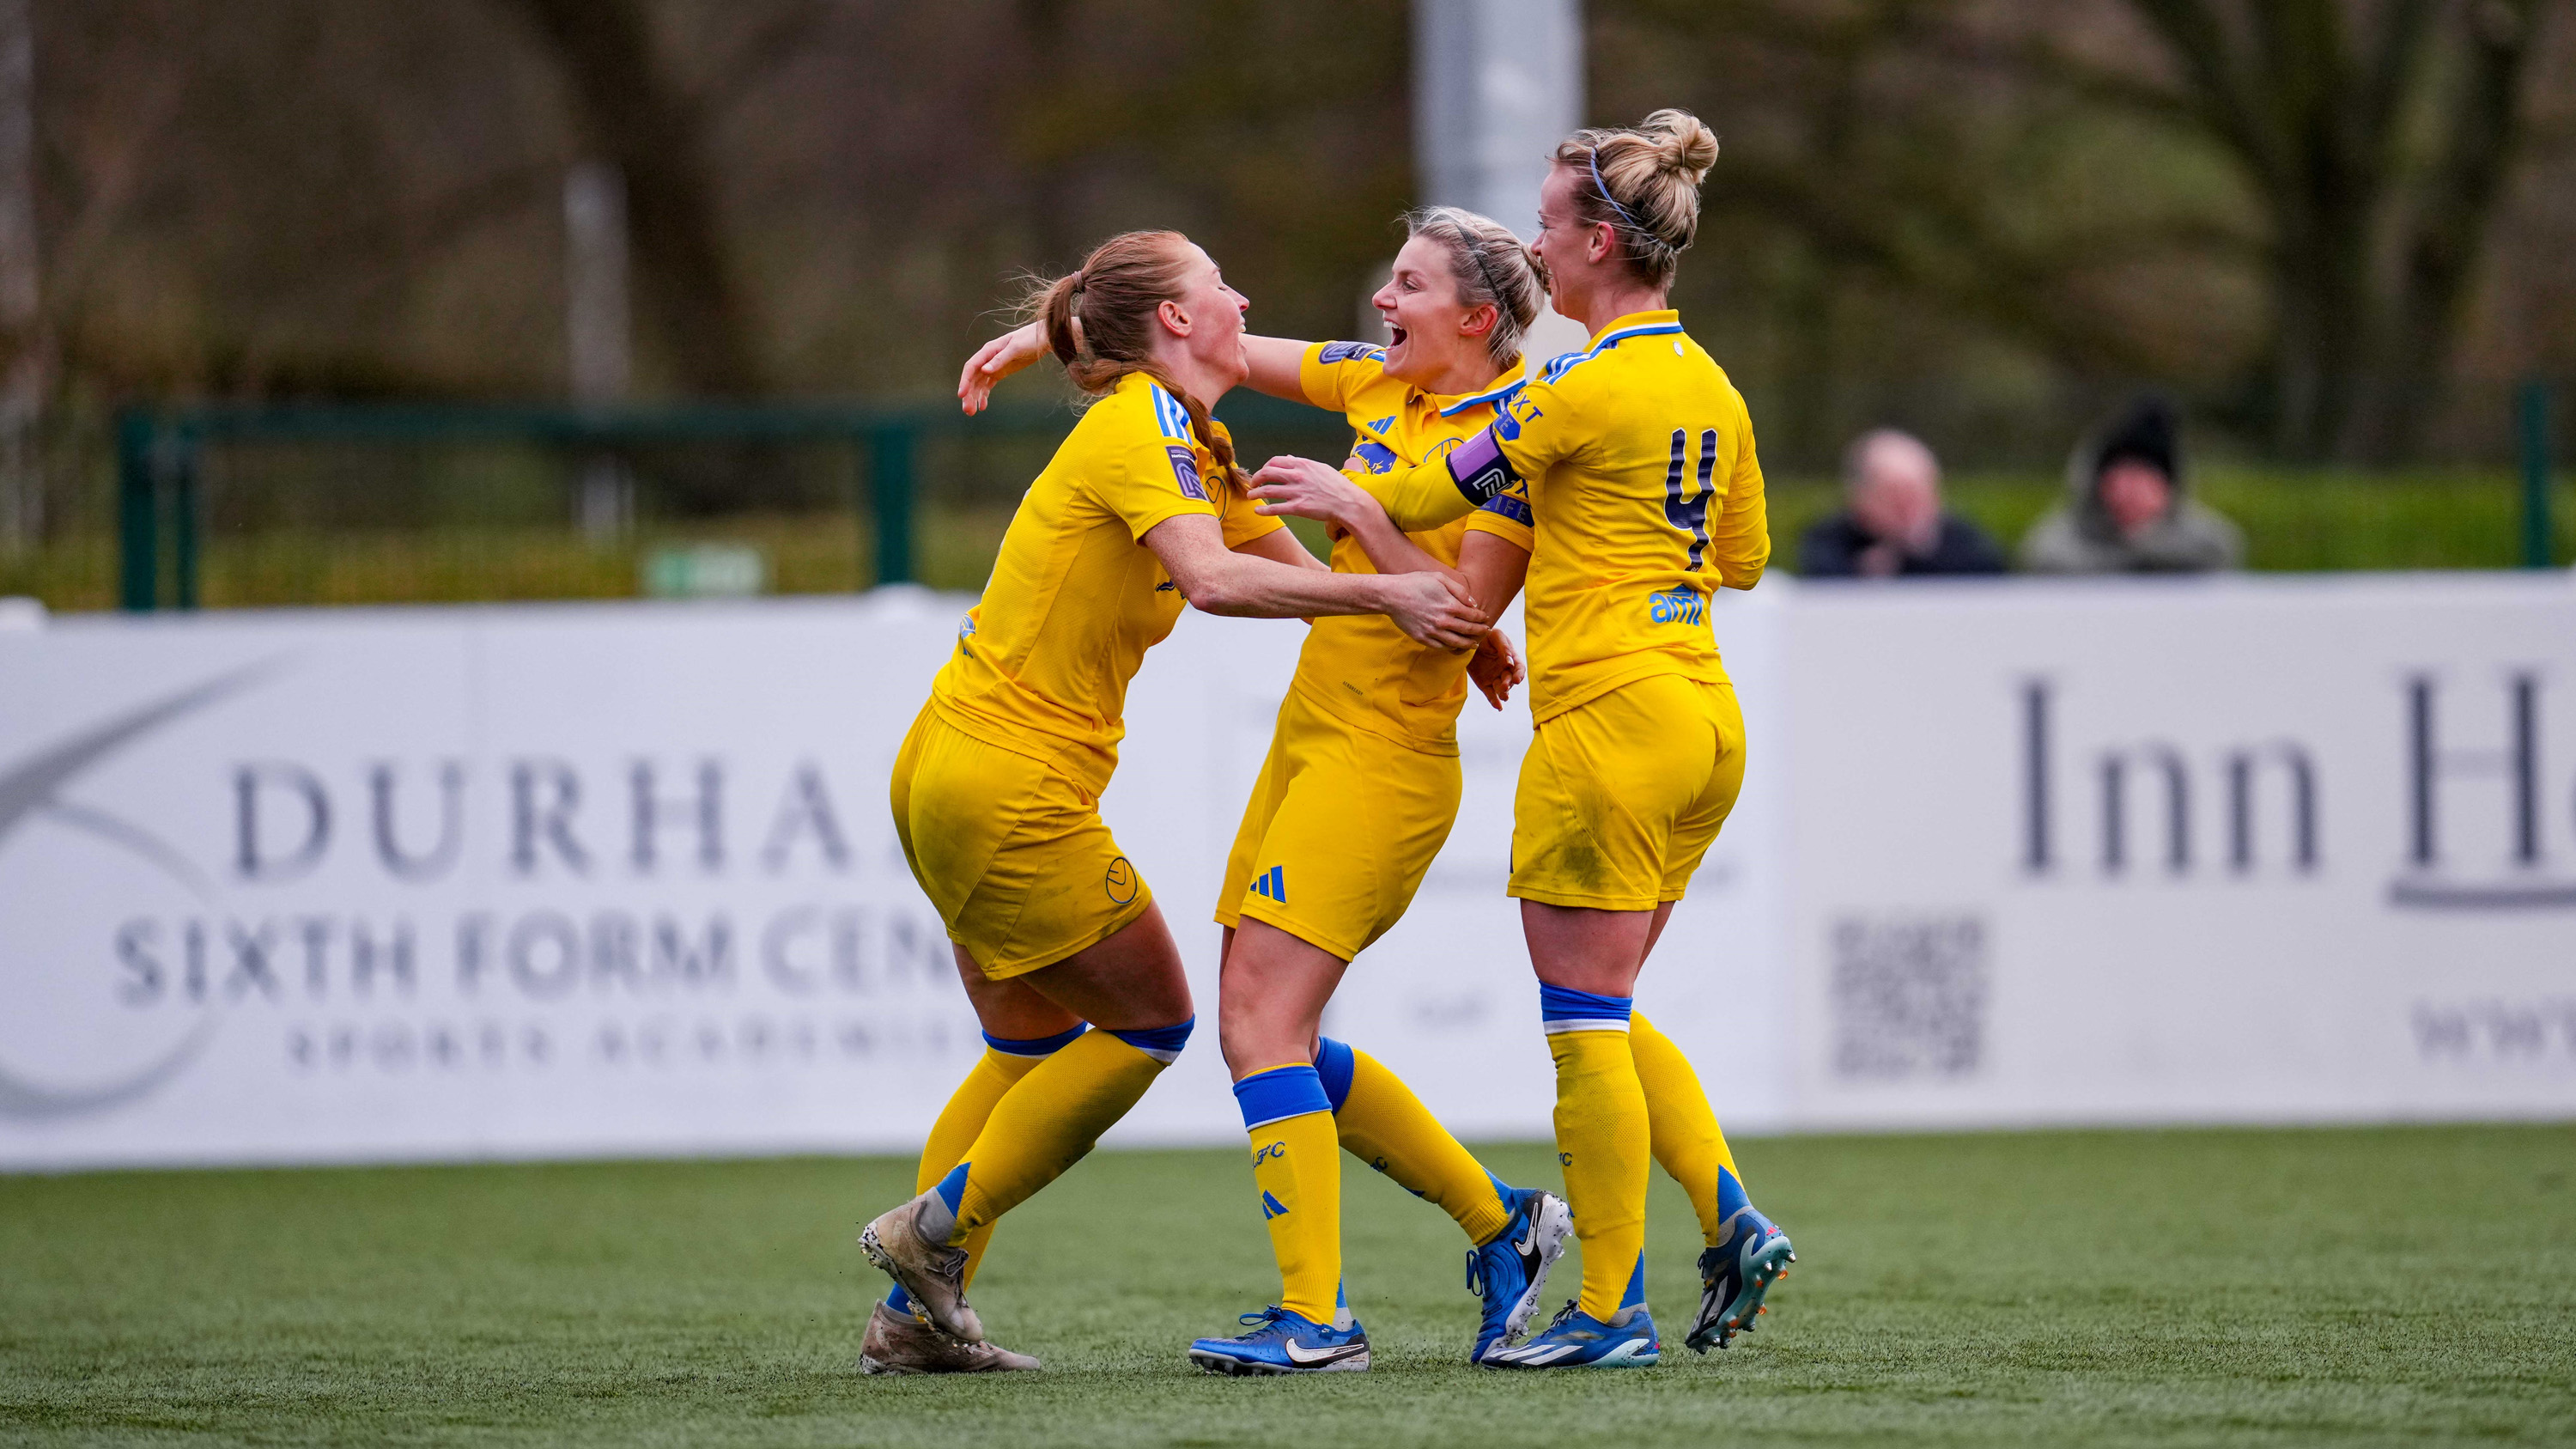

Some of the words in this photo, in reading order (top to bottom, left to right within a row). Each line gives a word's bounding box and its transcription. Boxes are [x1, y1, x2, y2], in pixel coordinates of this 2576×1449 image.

[1664, 428, 1717, 573] 4
[232, 758, 903, 880] DURHA
[2014, 673, 2324, 878] Inn
[2396, 668, 2576, 868] H
[115, 916, 416, 1005] SIXTH
[457, 909, 736, 1002] FORM
